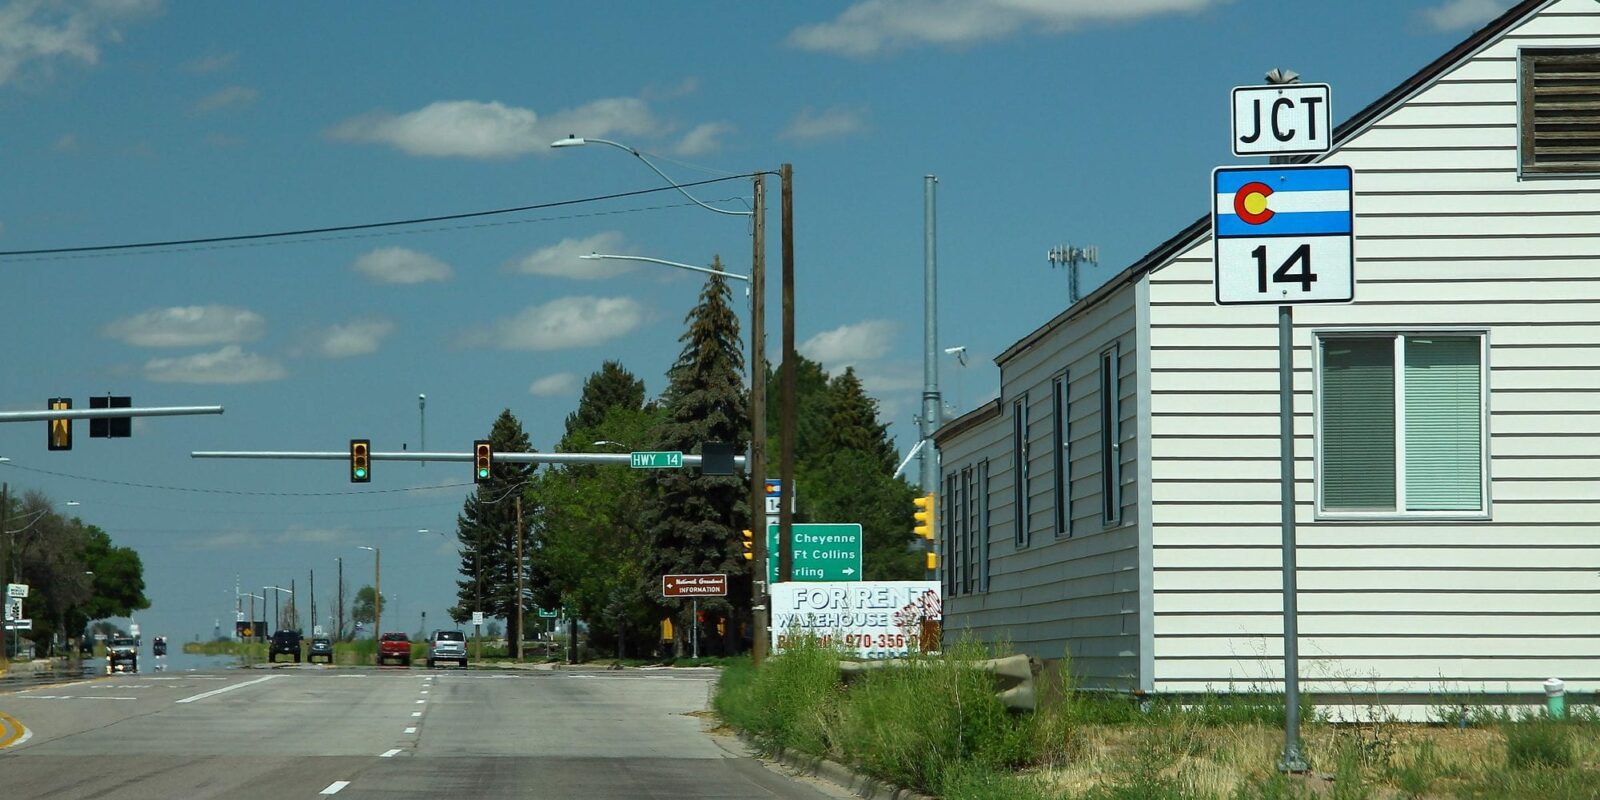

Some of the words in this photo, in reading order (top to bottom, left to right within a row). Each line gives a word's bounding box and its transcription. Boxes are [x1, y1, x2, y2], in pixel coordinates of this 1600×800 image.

[1239, 96, 1323, 144] JCT
[1251, 243, 1318, 294] 14
[633, 454, 656, 466] HWY
[666, 454, 678, 465] 14
[794, 533, 856, 545] Cheyenne
[793, 550, 808, 560] Ft
[812, 549, 856, 560] Collins
[774, 566, 824, 578] Srling
[792, 587, 848, 610] FOR
[855, 586, 930, 610] RENT
[776, 612, 888, 628] WAREHOUSE
